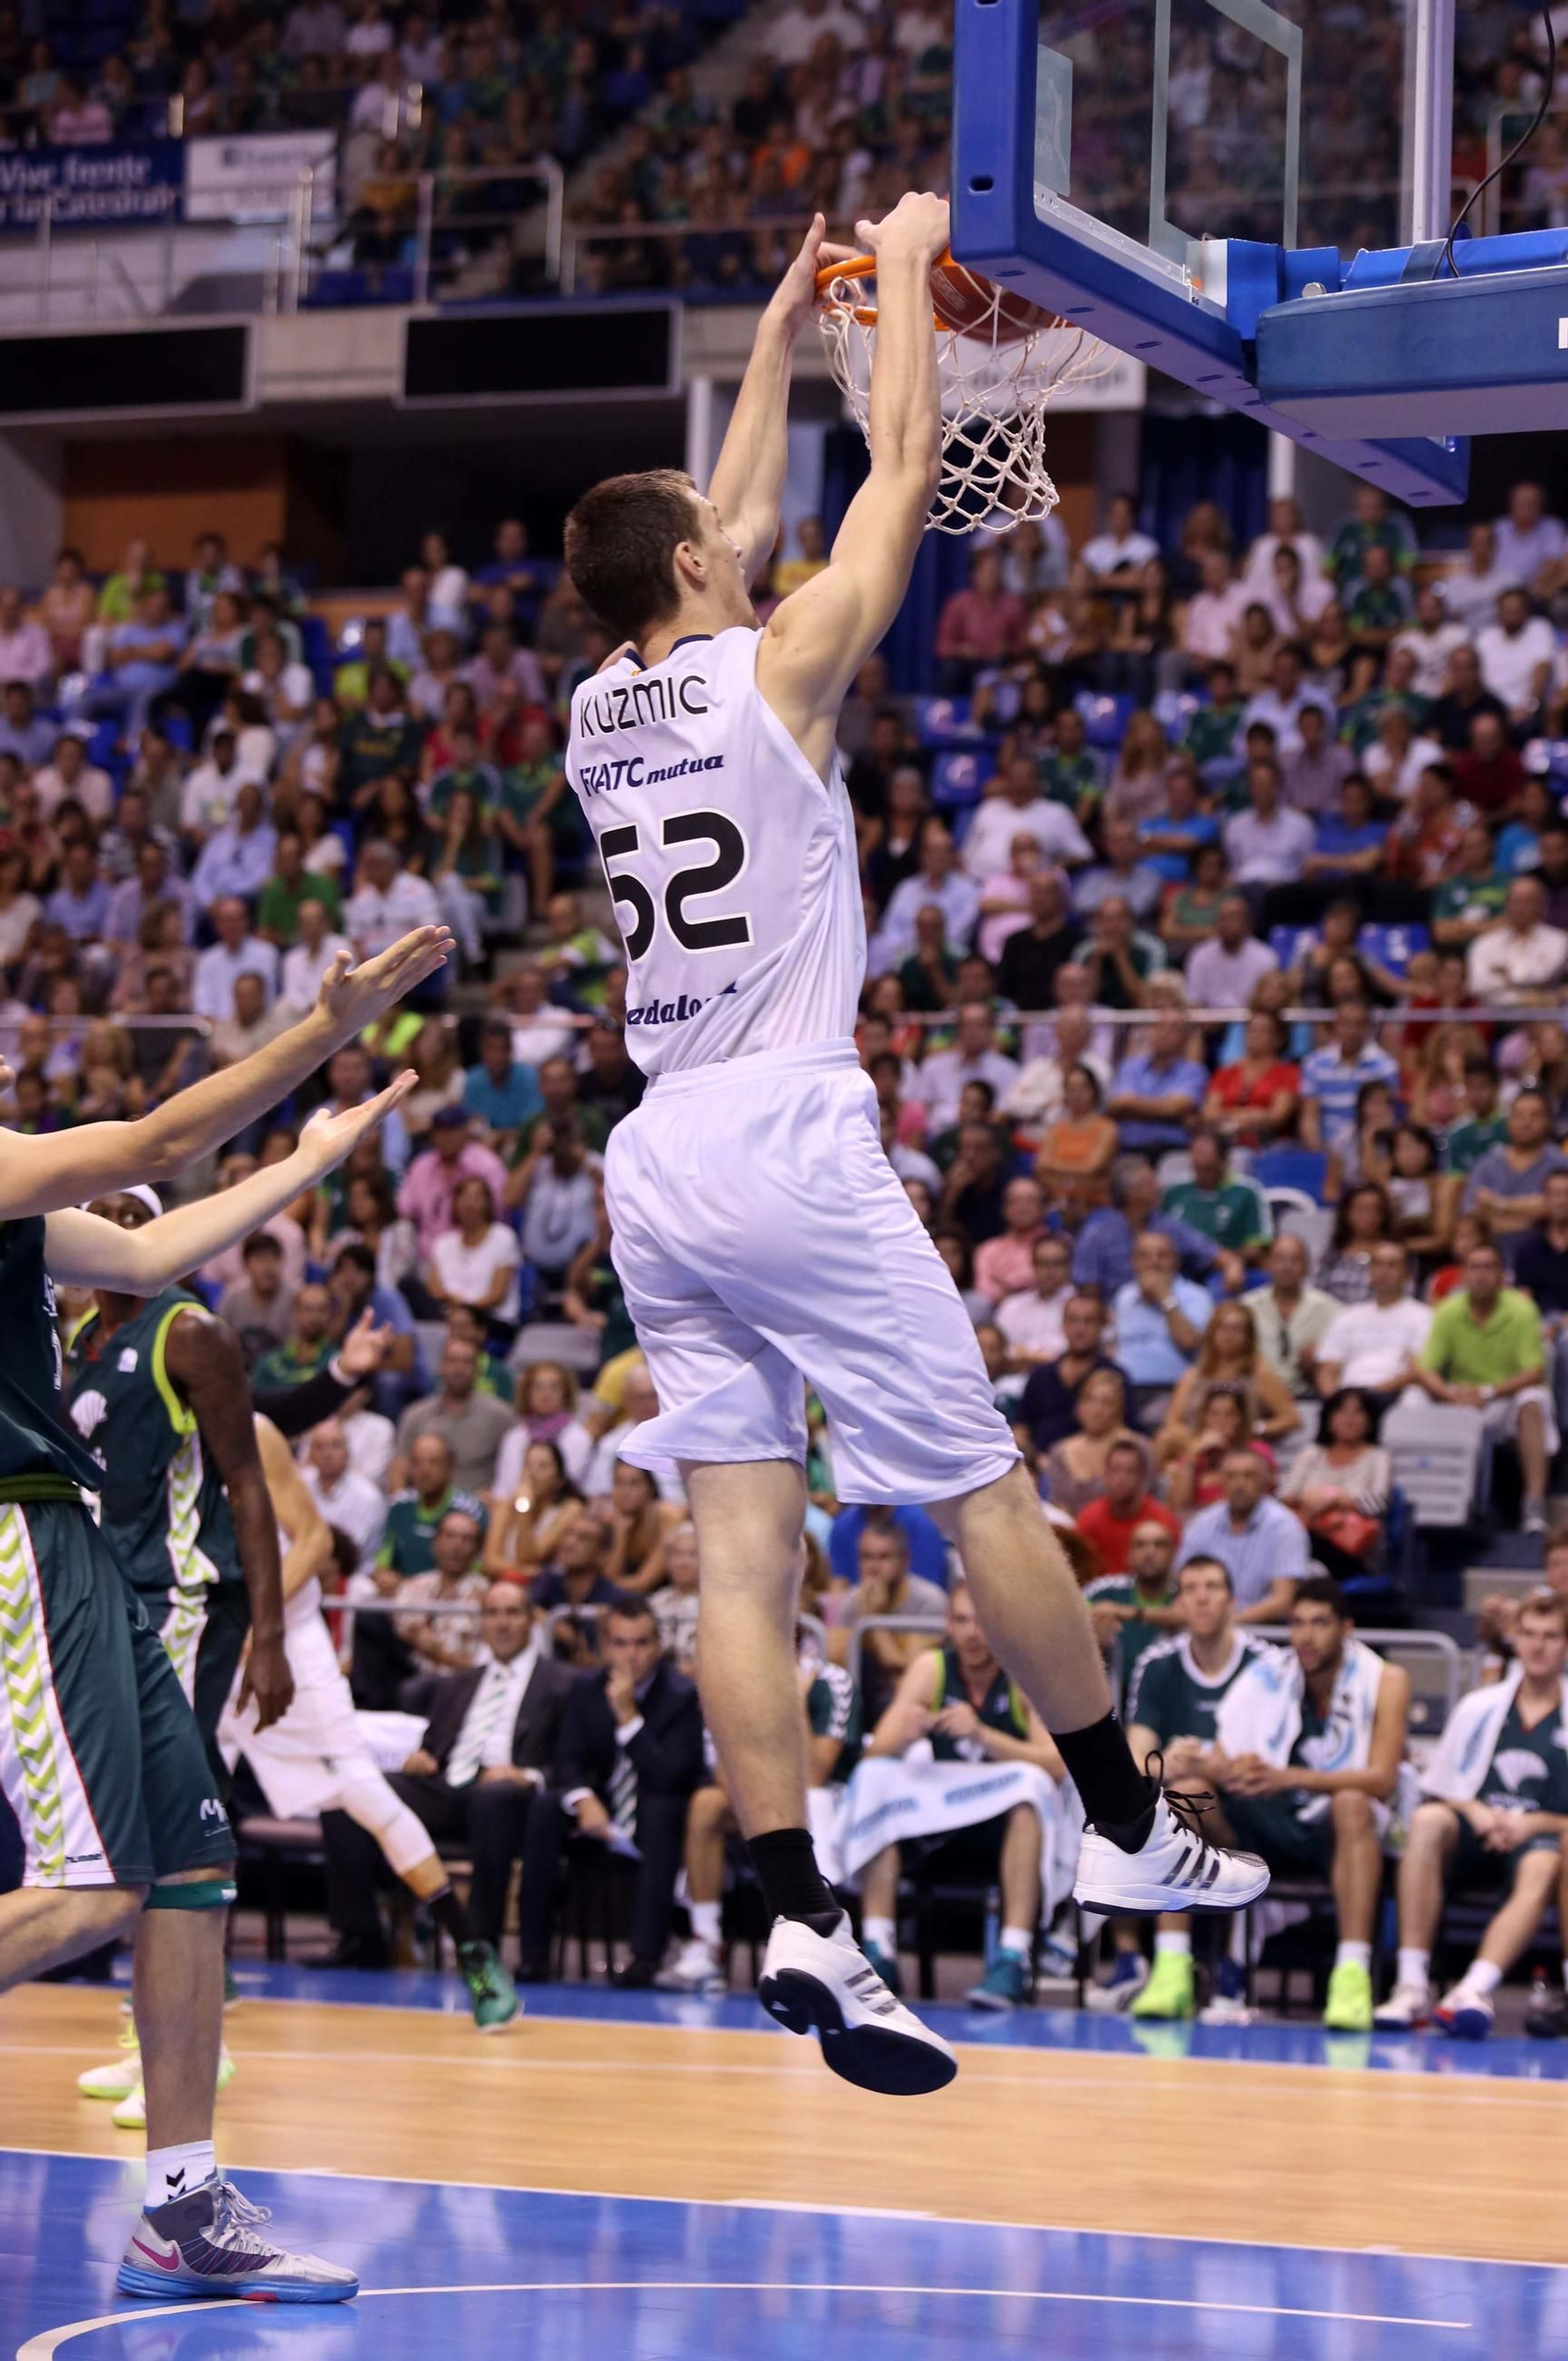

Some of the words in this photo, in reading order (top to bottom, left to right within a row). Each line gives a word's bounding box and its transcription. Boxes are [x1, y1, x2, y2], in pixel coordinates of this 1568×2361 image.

[580, 674, 709, 739] KUZMIC
[579, 756, 645, 797] FIATC
[646, 755, 725, 785] mutua
[600, 811, 750, 961] 52
